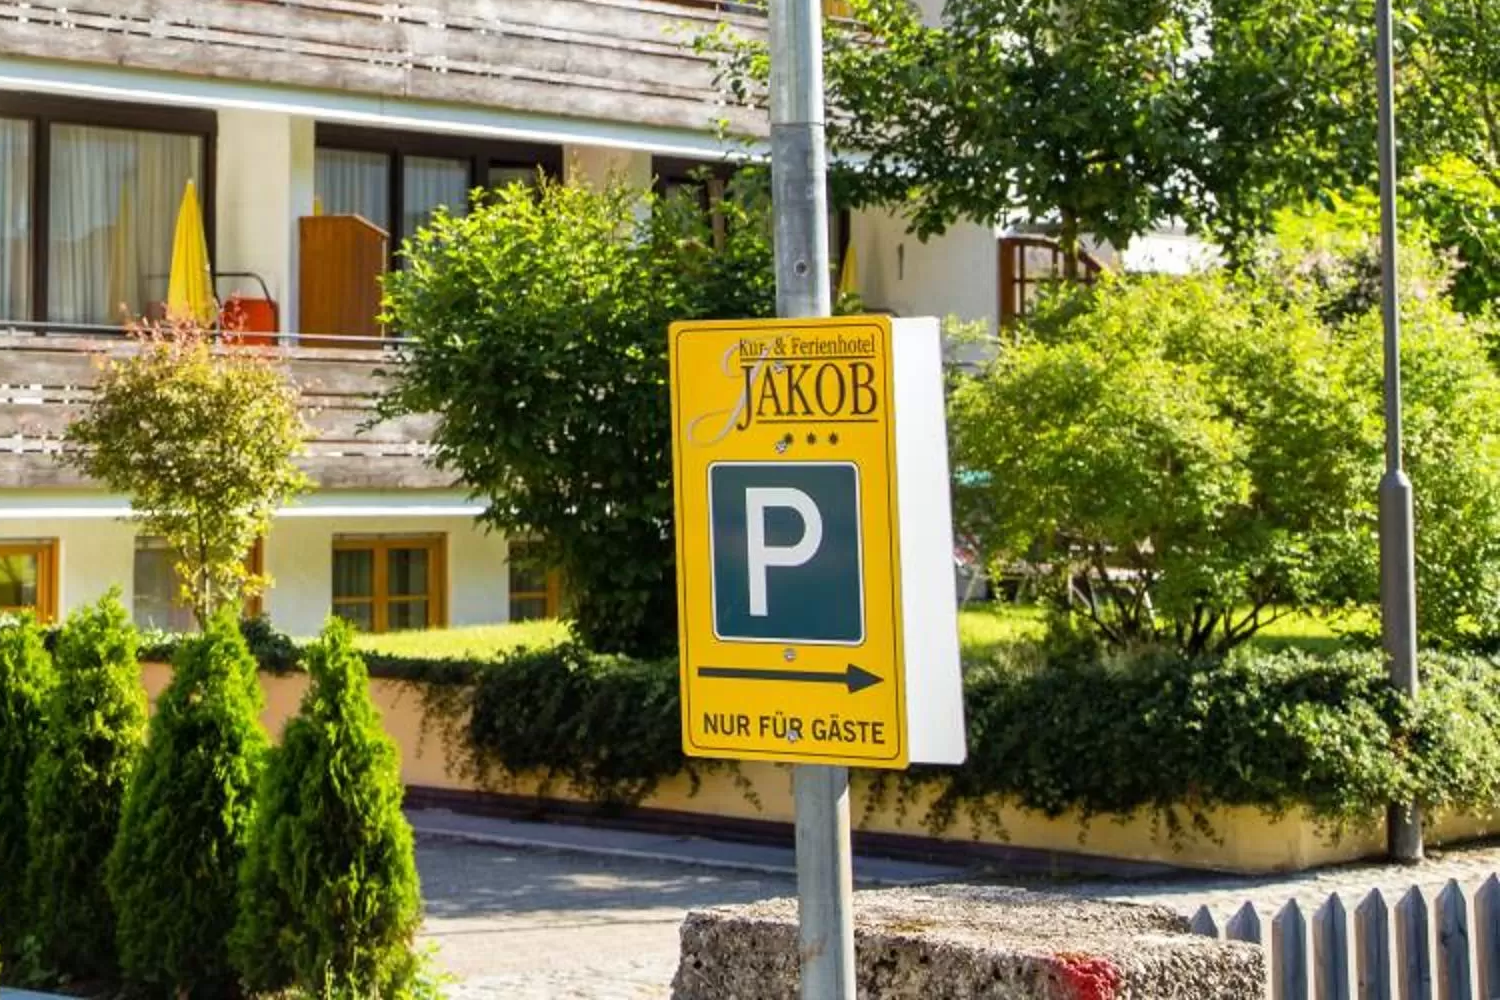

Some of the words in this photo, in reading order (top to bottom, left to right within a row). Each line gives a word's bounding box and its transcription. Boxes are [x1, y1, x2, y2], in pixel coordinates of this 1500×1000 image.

[773, 335, 787, 356] &
[791, 333, 876, 355] Ferienhotel
[736, 361, 879, 431] JAKOB
[745, 487, 823, 617] P
[703, 712, 750, 737] NUR
[758, 711, 803, 740] FÜR
[811, 714, 886, 745] GÄSTE
